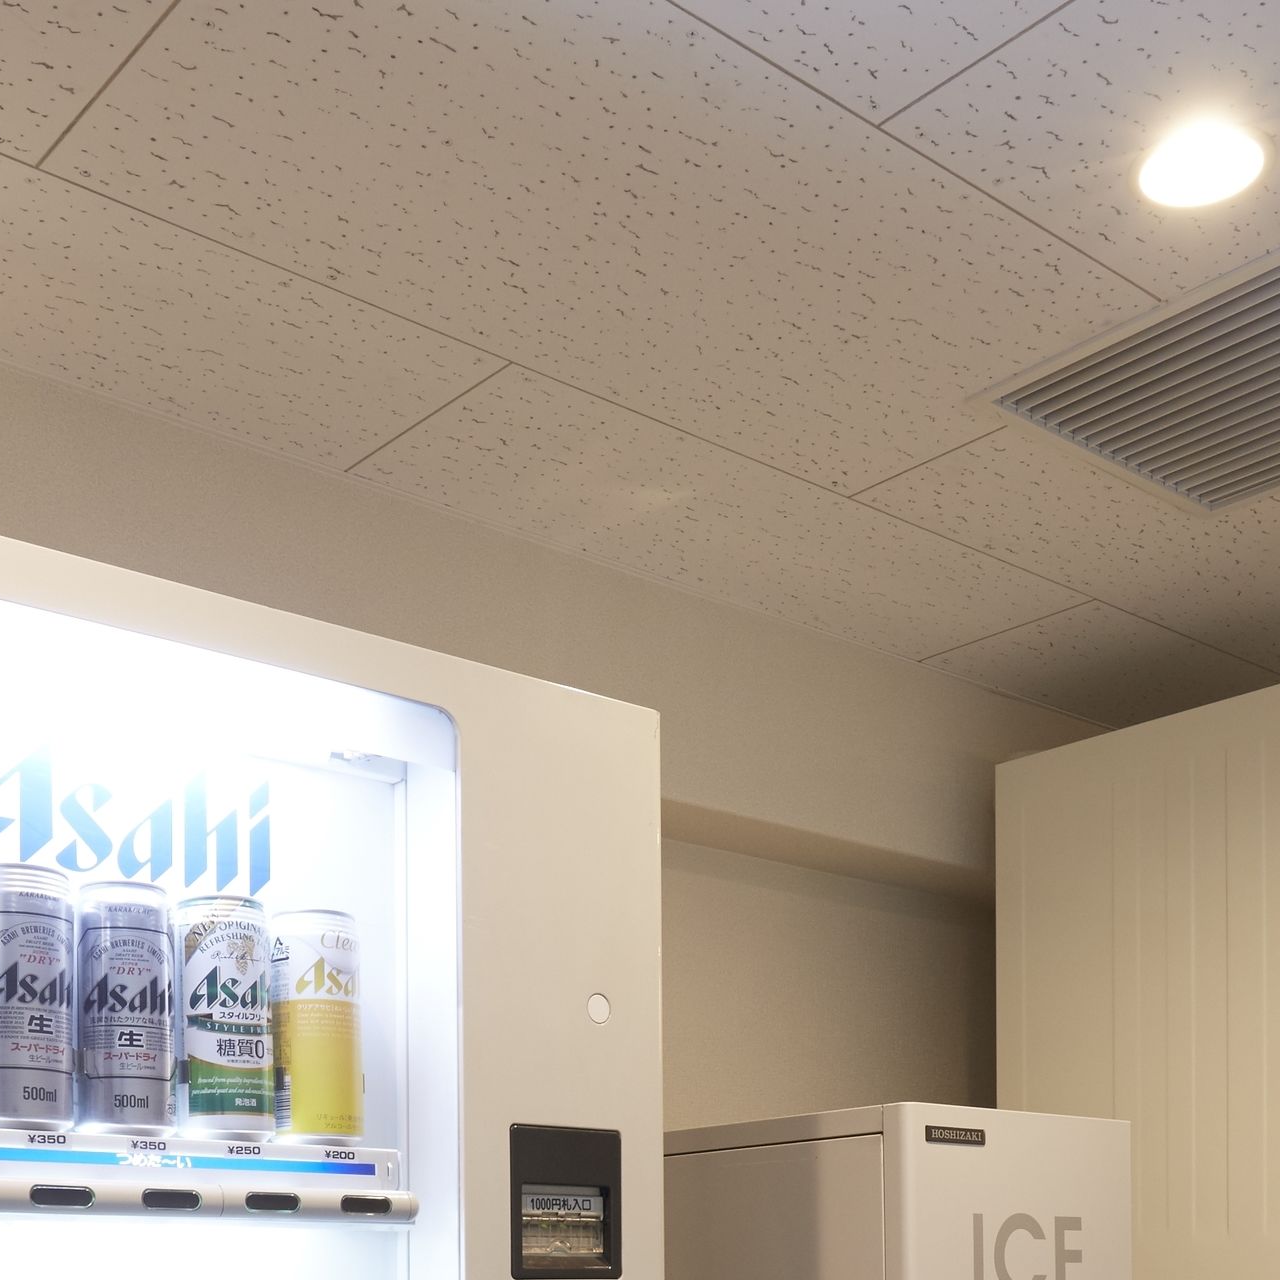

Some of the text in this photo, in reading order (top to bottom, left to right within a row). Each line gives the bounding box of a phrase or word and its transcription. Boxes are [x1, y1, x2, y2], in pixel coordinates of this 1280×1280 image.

[26, 1014, 53, 1037] 生
[117, 1031, 145, 1050] 生
[10, 1042, 65, 1057] スーパードライ
[102, 1052, 159, 1066] スーパードライ
[22, 1086, 58, 1104] 500ml
[113, 1093, 150, 1110] 500ml
[27, 1133, 67, 1146] ¥350
[931, 1127, 982, 1142] HOSHIZAKI
[131, 1140, 168, 1152] ¥350
[227, 1145, 261, 1156] ¥250
[324, 1149, 356, 1161] ¥200
[530, 1197, 592, 1211] 1000円札入口
